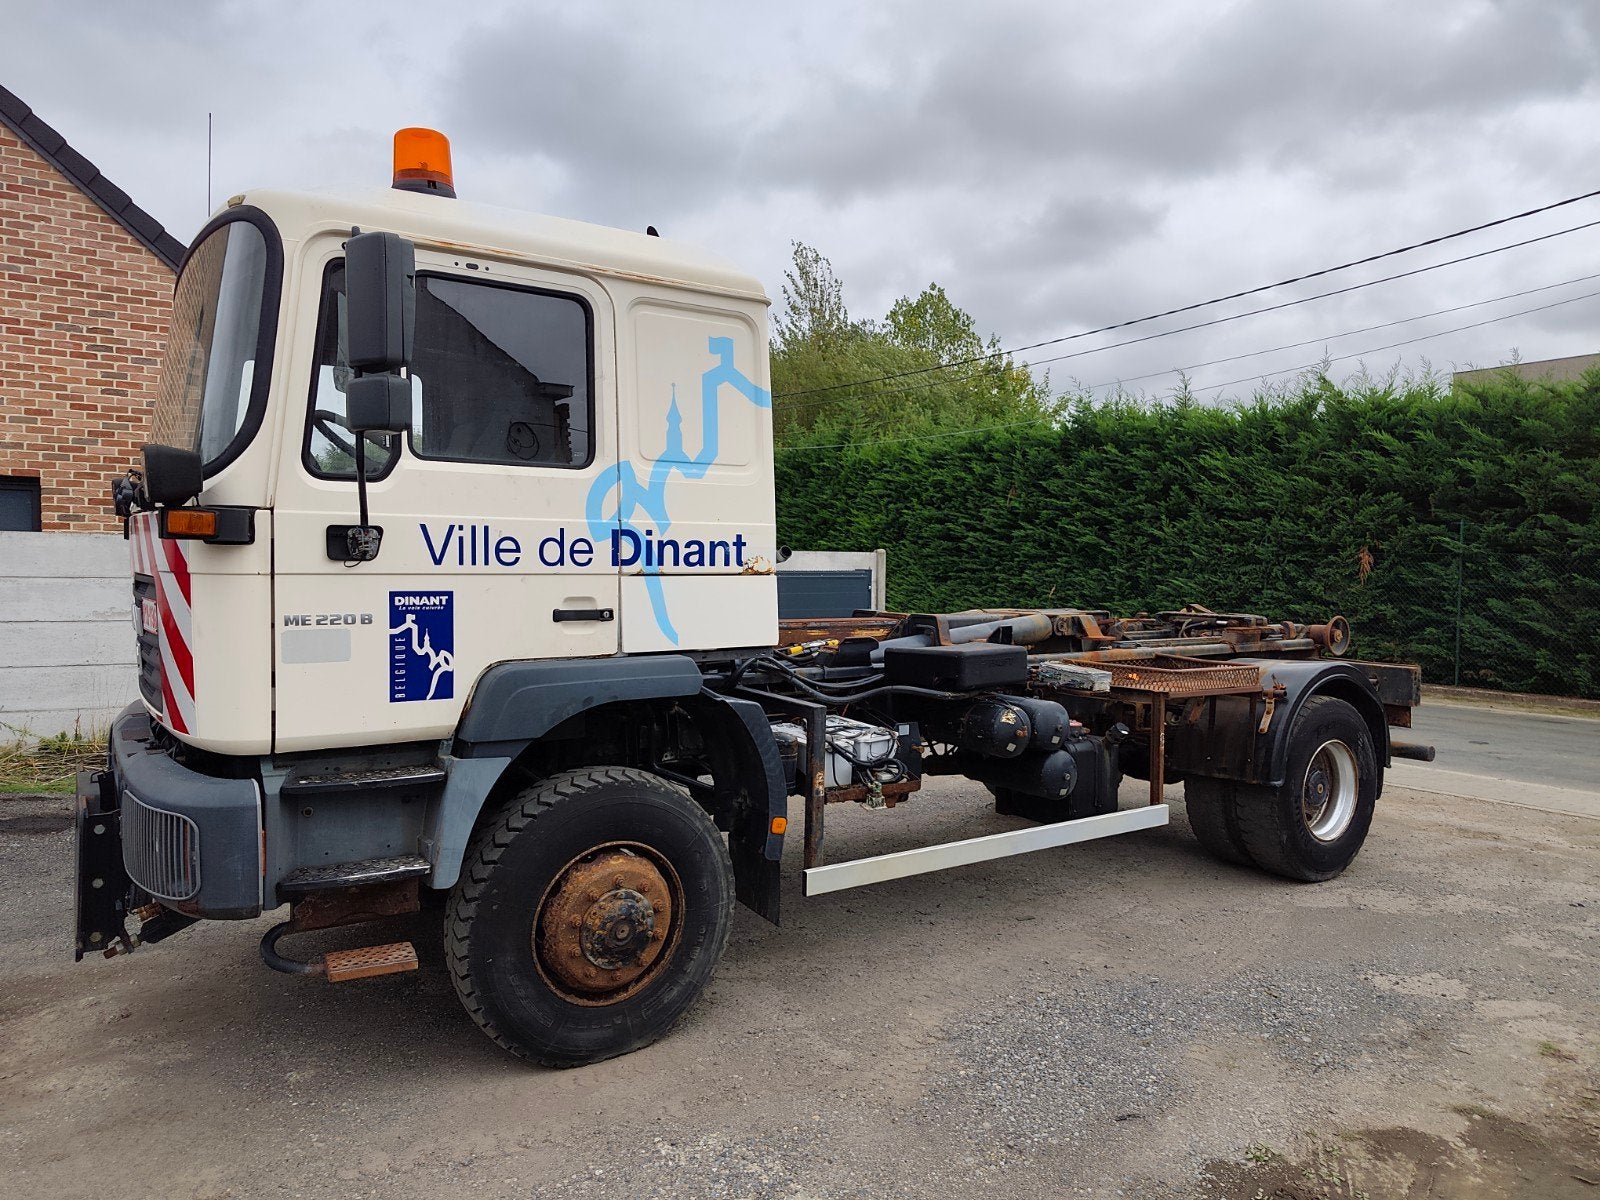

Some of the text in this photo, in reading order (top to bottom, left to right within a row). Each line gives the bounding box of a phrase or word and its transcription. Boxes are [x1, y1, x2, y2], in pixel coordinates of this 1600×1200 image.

[419, 523, 748, 568] Ville de Dinant
[394, 596, 449, 606] DINANT
[283, 613, 374, 626] ME 220 B
[394, 637, 406, 699] BELGIQUE
